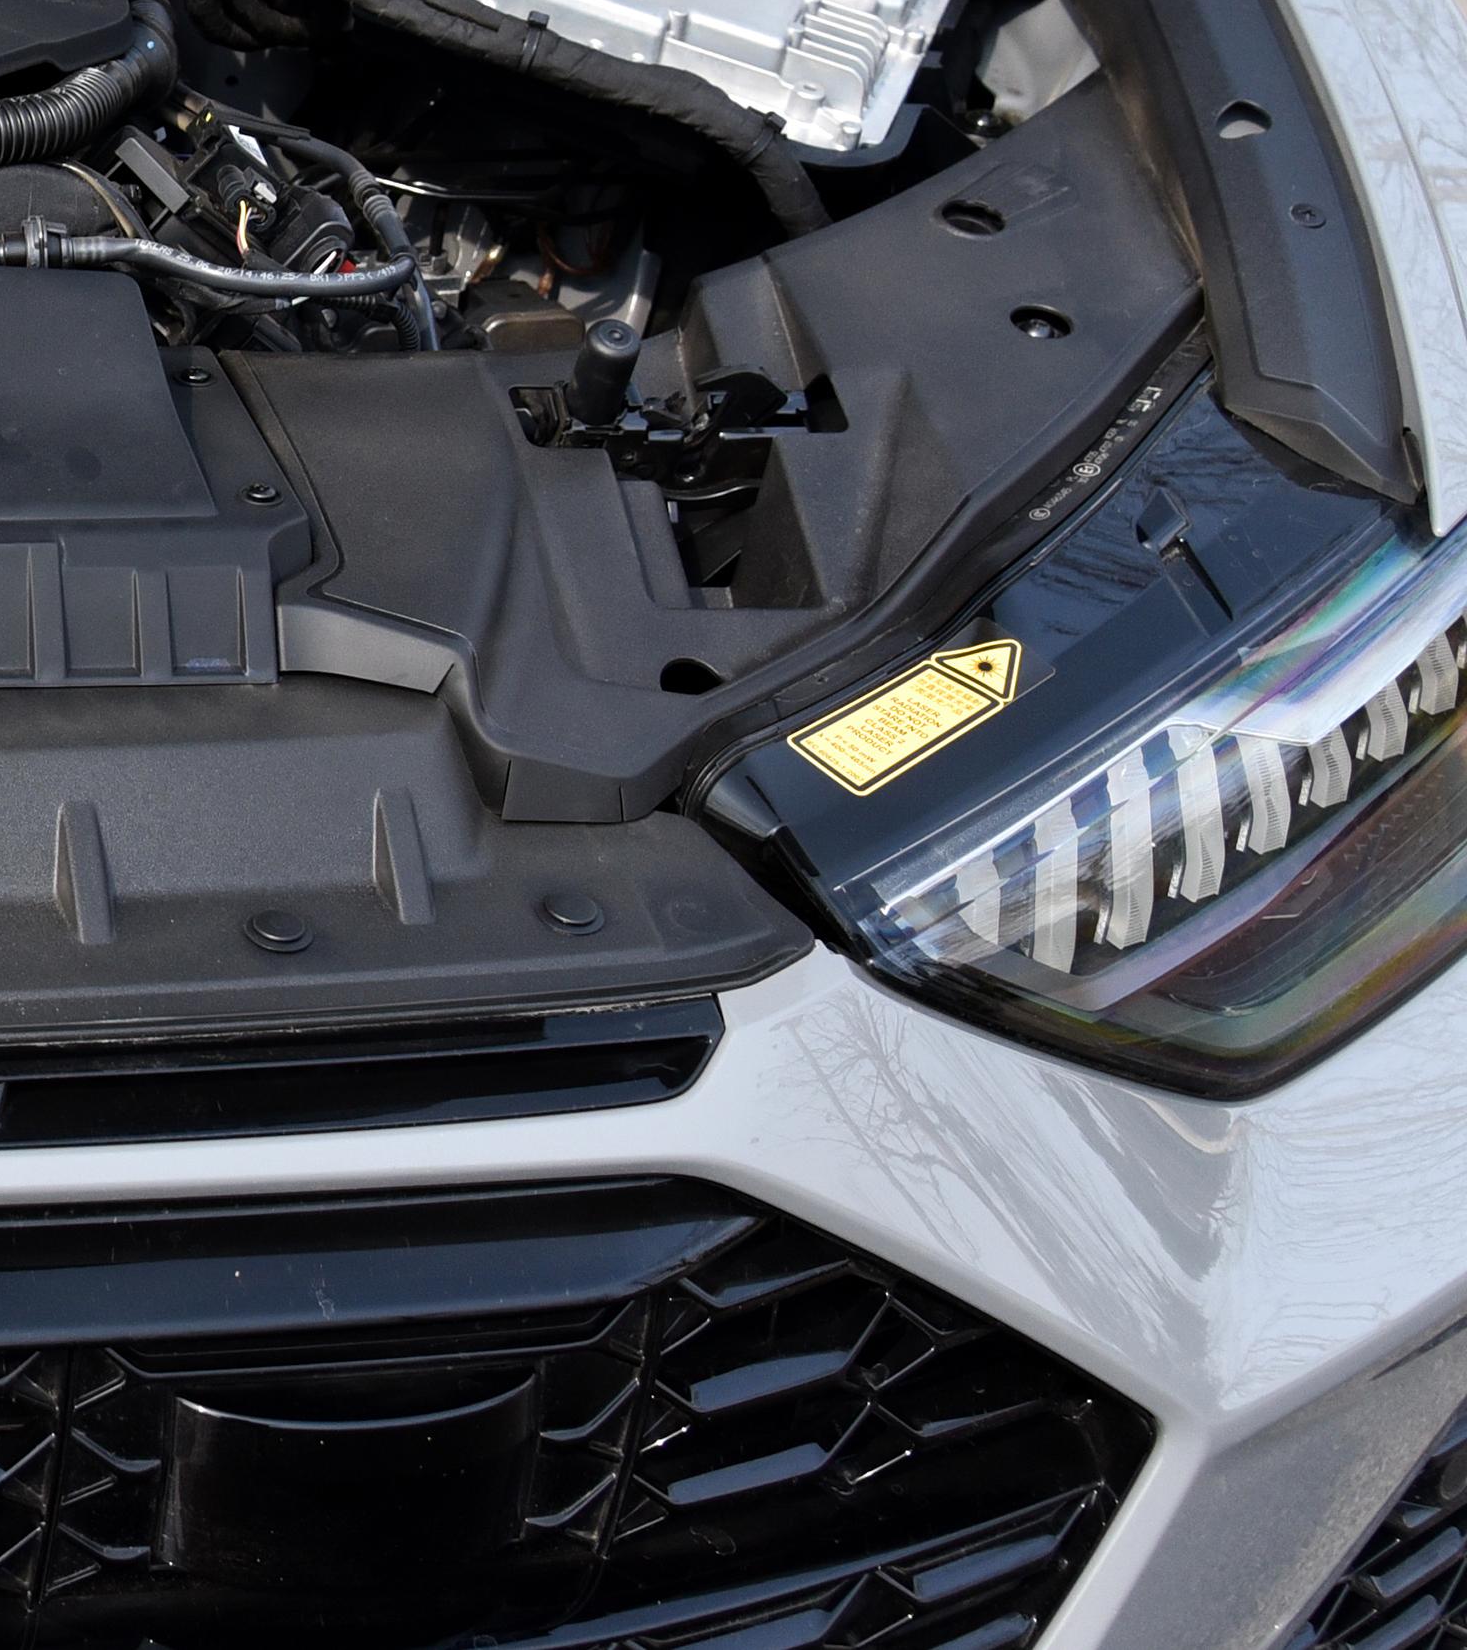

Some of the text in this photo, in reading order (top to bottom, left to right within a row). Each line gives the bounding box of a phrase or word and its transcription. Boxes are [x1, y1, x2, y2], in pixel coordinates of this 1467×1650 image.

[888, 705, 927, 728] DO NOT
[889, 696, 942, 728] RADIATION
[906, 696, 941, 718] LASER
[863, 717, 899, 740] CLASS
[871, 704, 929, 739] STARE INTO
[876, 716, 908, 736] BEAM
[844, 724, 893, 756] PRODUCT
[859, 724, 894, 747] LASER
